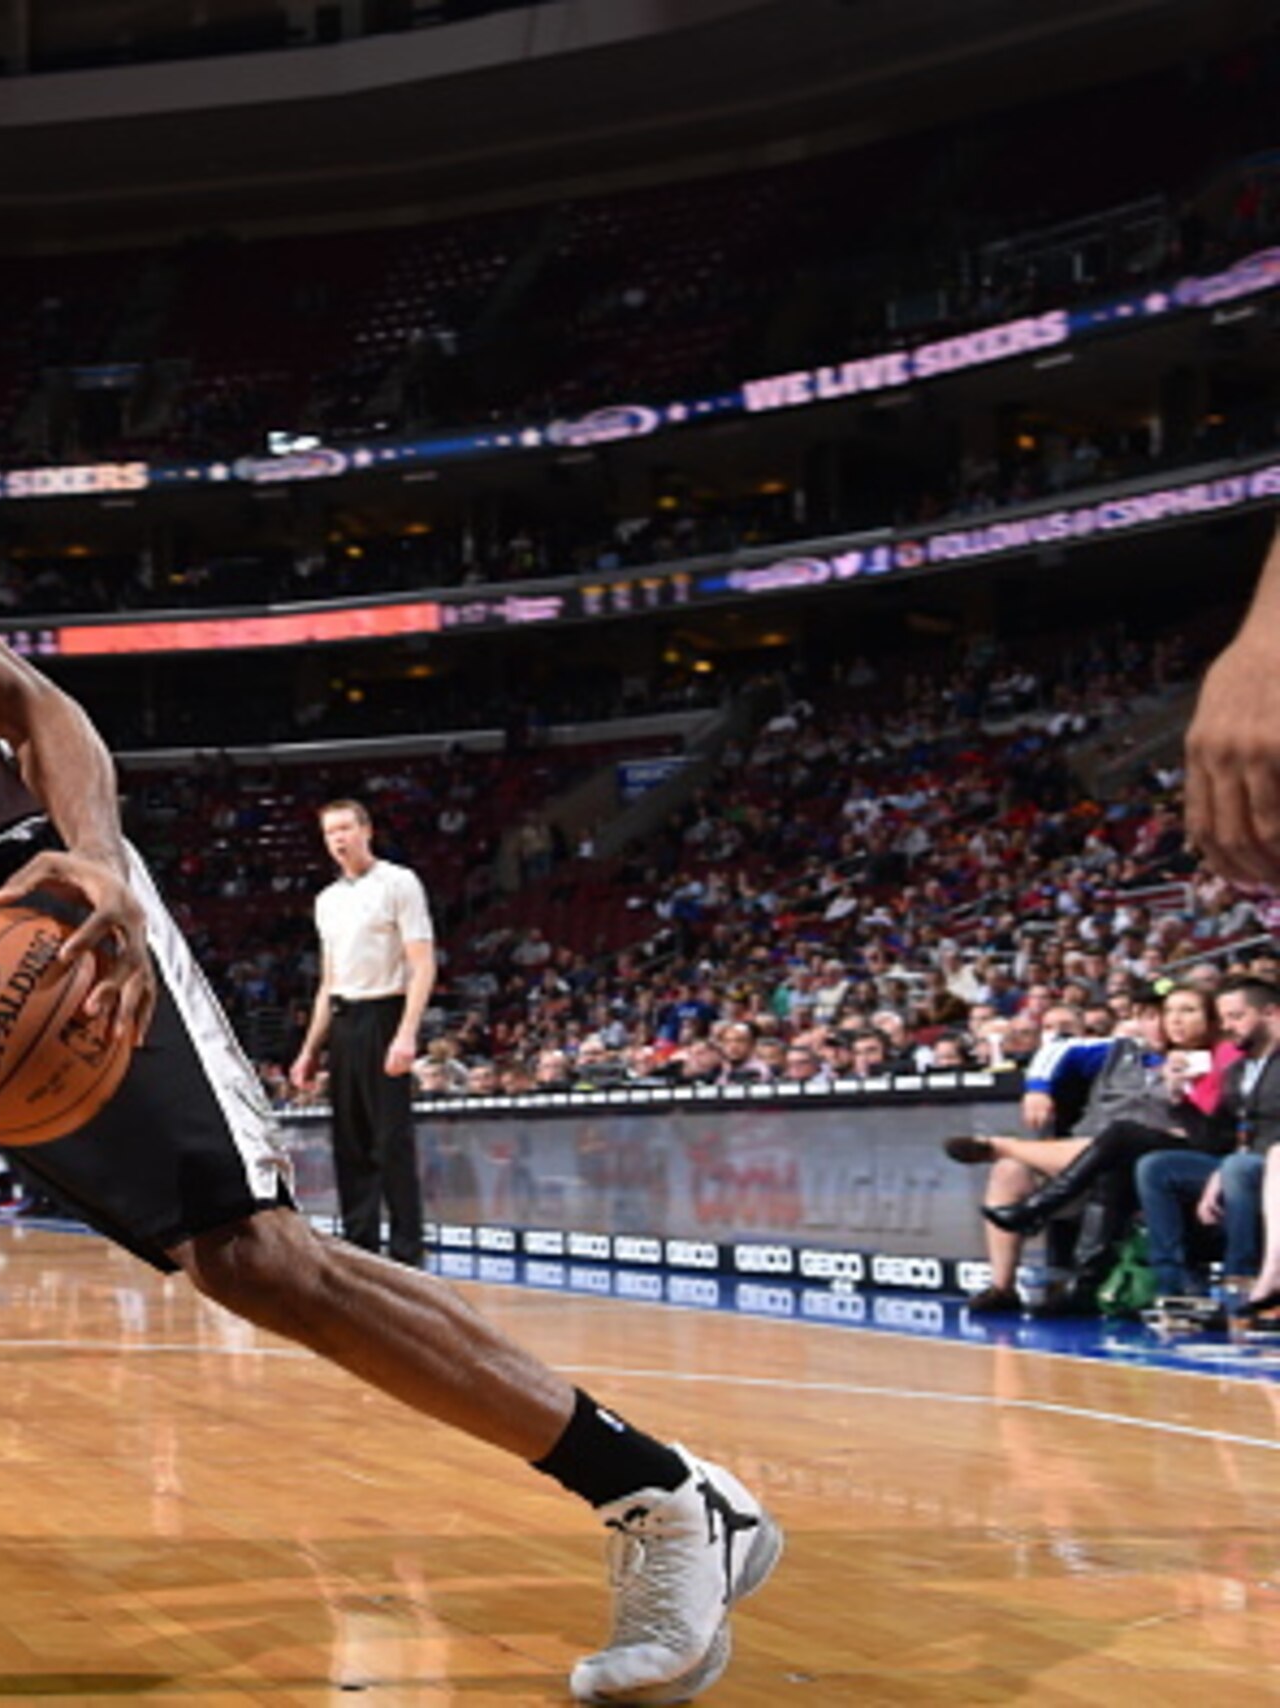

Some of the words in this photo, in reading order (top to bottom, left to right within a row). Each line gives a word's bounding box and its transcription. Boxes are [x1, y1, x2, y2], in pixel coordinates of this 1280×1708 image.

[742, 371, 813, 412] WE
[815, 350, 911, 398] LIVE
[913, 309, 1070, 378] SIXERS
[6, 461, 149, 497] SIXERS
[799, 1249, 863, 1280] GEICO
[872, 1256, 942, 1286] GEICO
